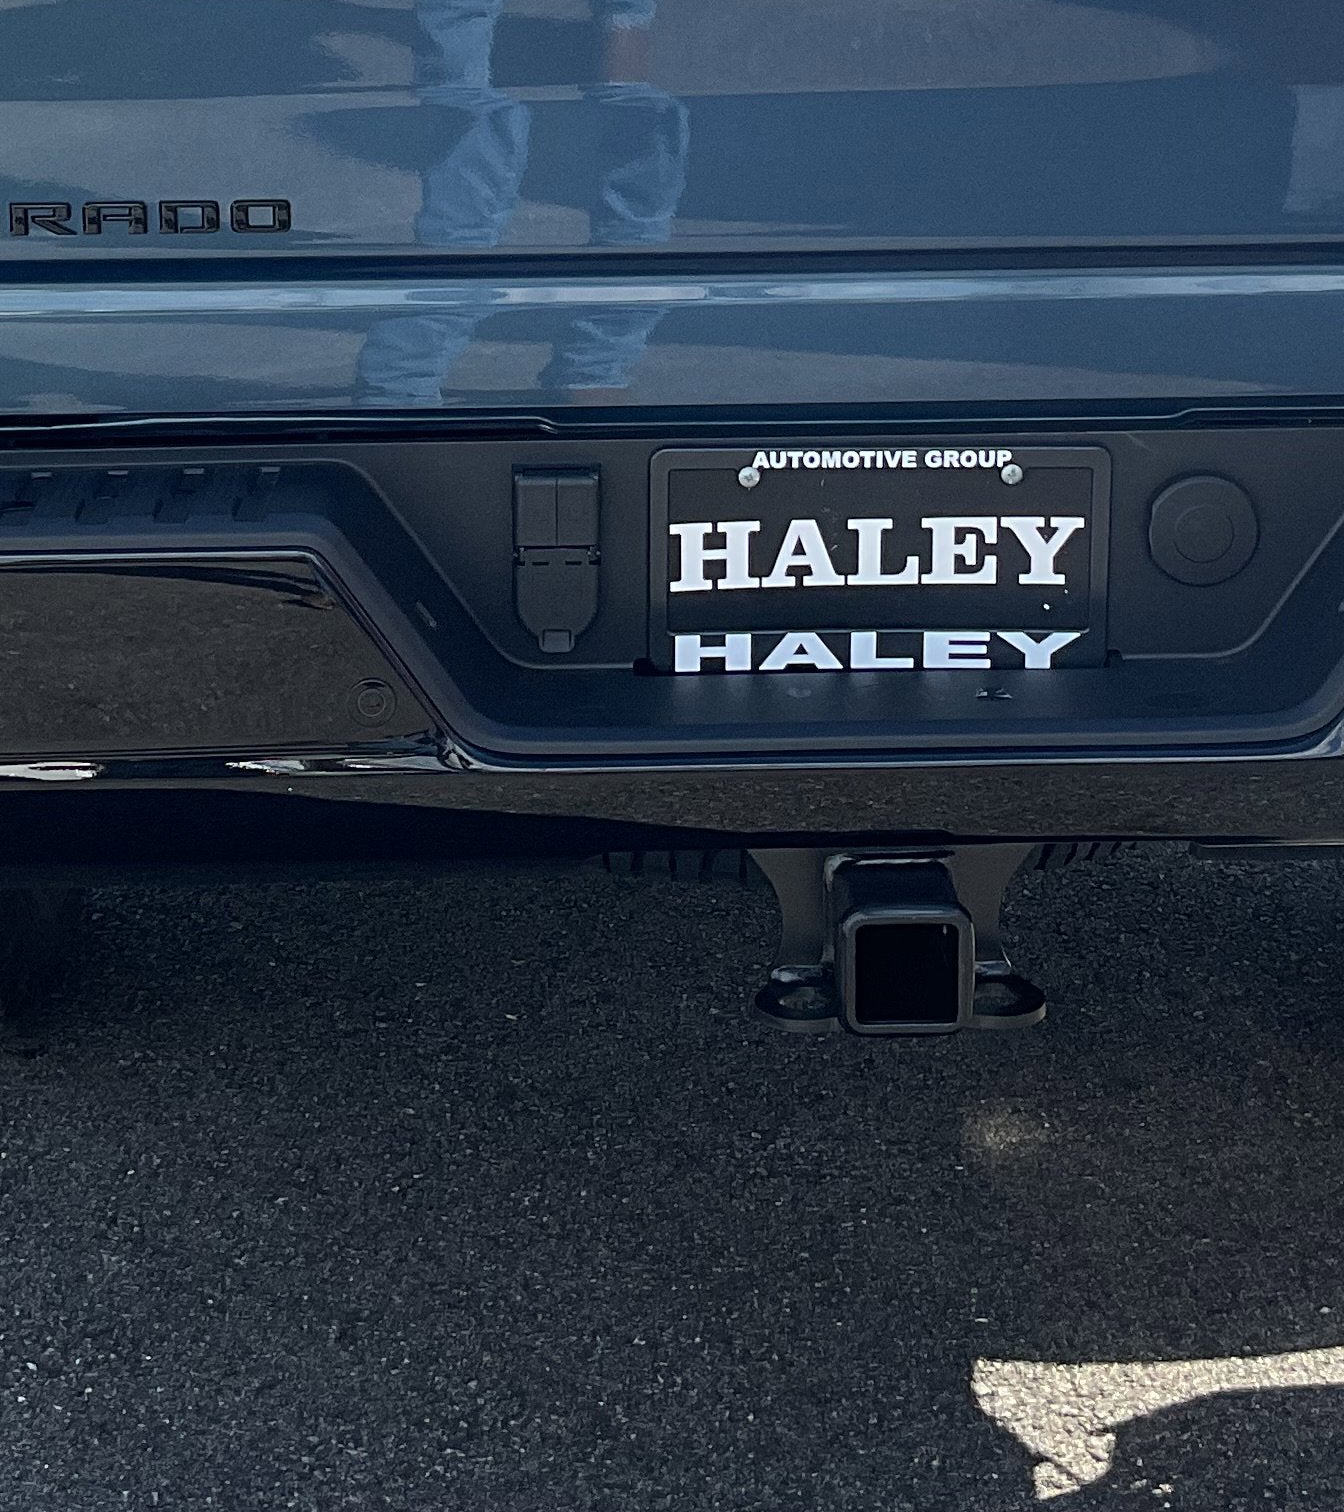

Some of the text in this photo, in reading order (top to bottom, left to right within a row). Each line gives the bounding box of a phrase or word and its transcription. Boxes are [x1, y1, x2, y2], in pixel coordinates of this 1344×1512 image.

[752, 449, 1013, 469] AUTOMOTIVE GROUP
[668, 516, 1086, 593] HALEY
[674, 631, 1082, 673] HALEY
